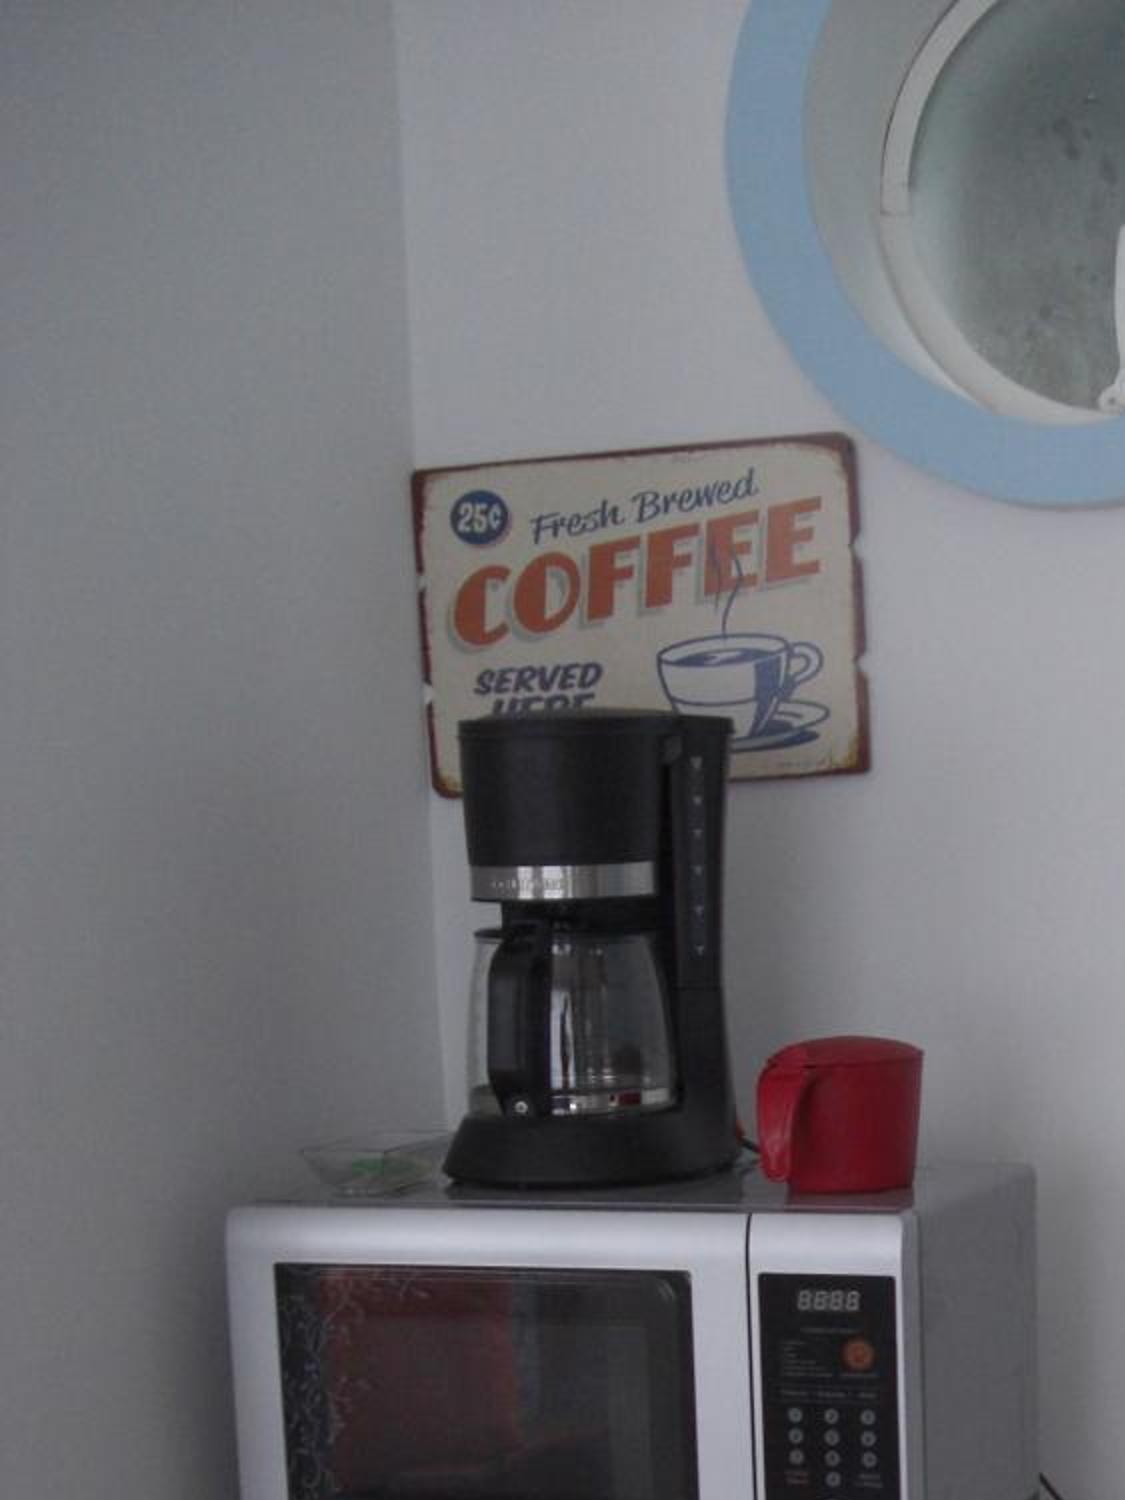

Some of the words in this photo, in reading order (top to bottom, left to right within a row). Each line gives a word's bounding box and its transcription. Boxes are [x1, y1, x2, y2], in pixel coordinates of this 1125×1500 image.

[531, 504, 624, 543] Fresh
[632, 467, 759, 522] Brewed
[452, 497, 822, 647] COFFEE
[474, 663, 604, 695] SERVED
